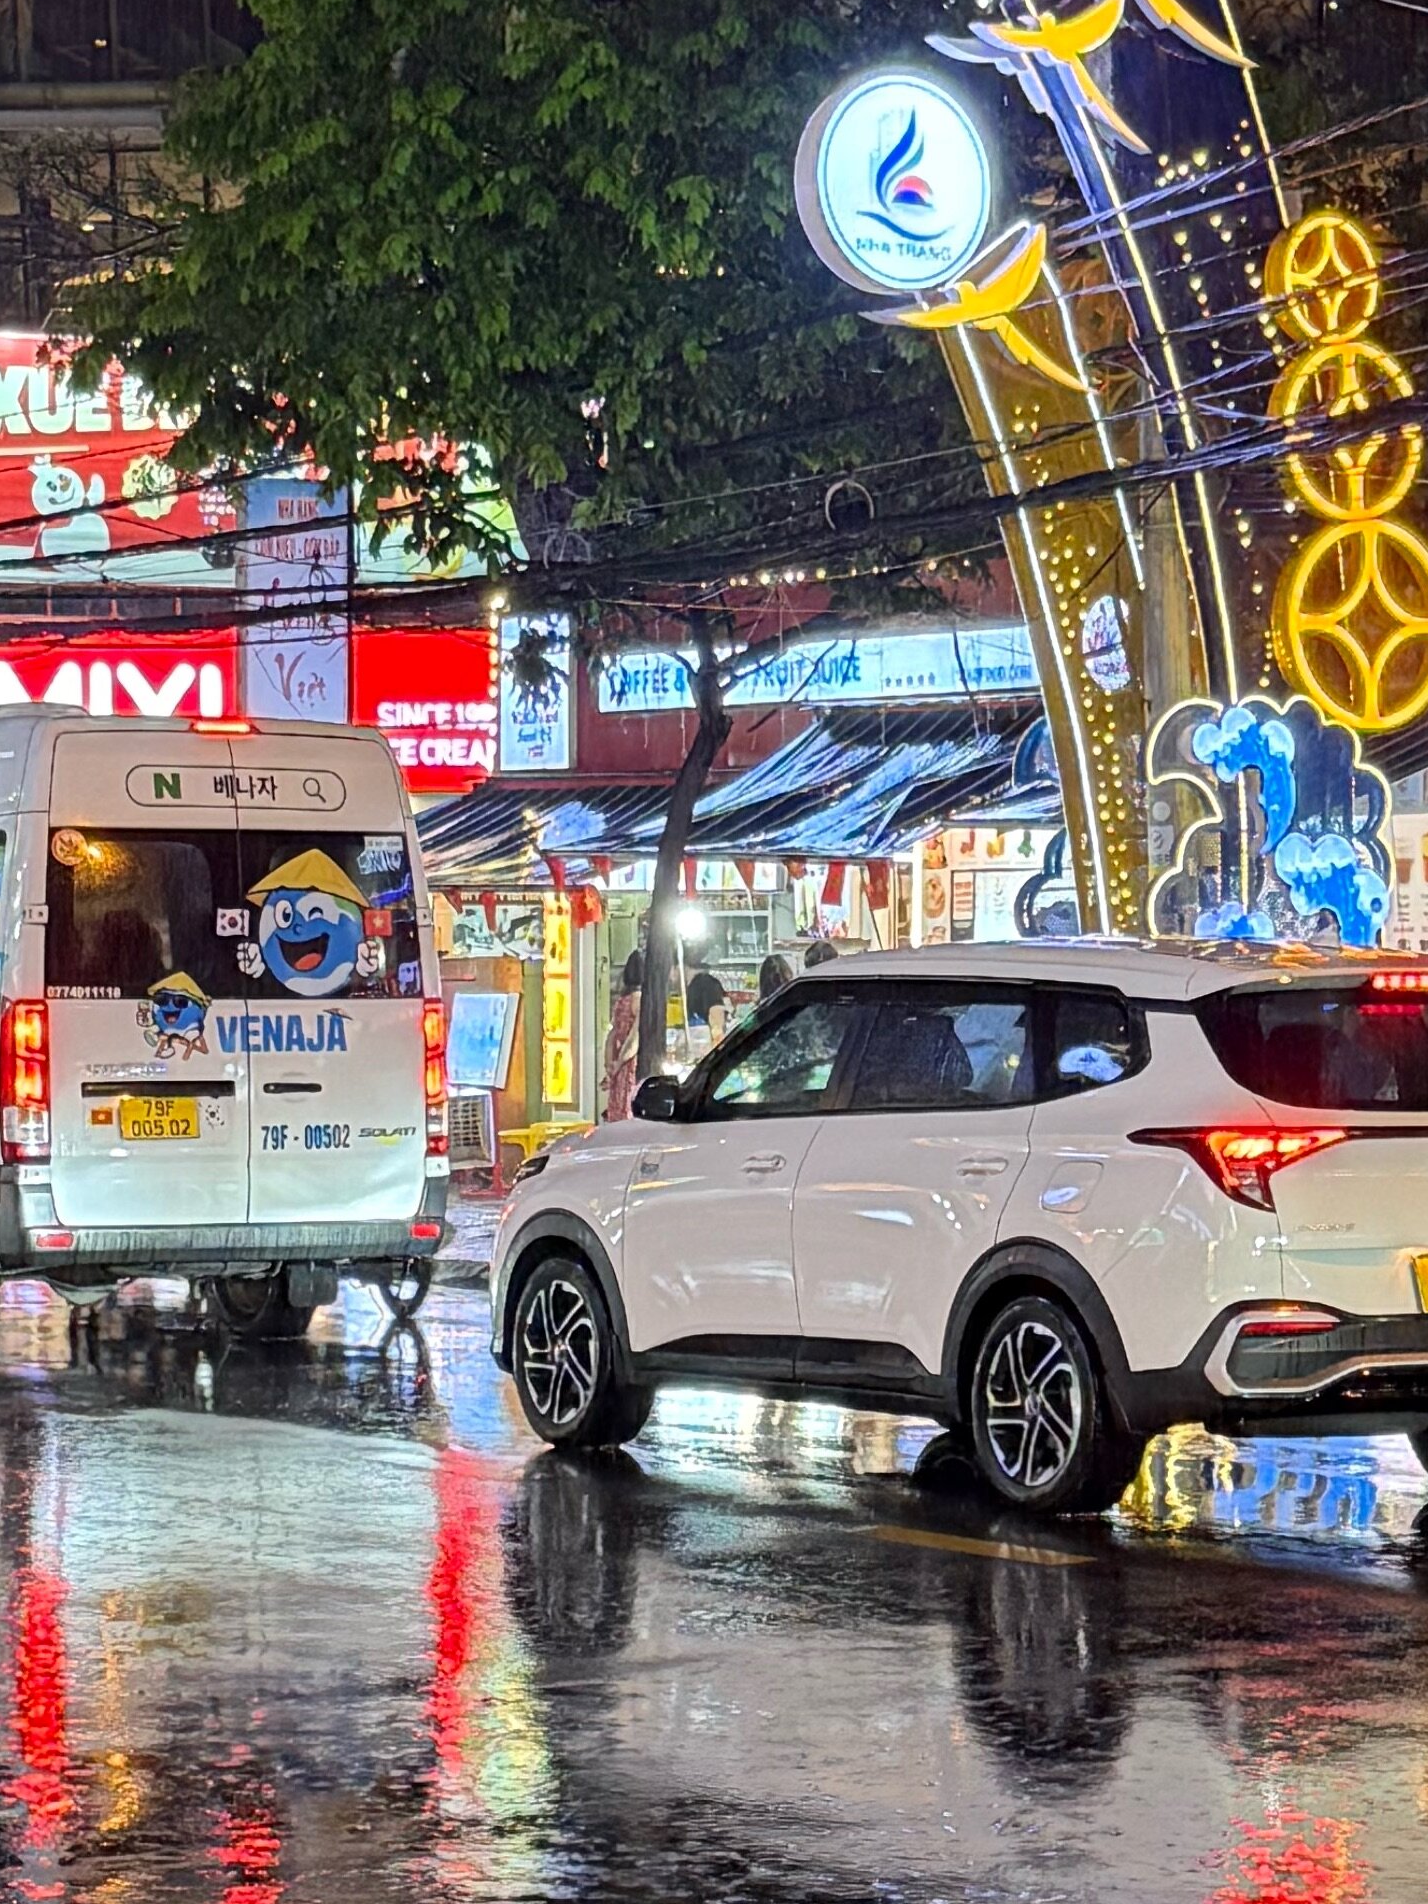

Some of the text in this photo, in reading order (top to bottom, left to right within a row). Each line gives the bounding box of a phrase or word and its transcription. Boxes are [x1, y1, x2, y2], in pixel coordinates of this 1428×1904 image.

[153, 772, 278, 801] N 베나자
[215, 1013, 348, 1054] VENAJA
[142, 1099, 175, 1118] 79F
[131, 1119, 191, 1137] 005.02
[261, 1125, 288, 1150] 79F
[304, 1124, 351, 1149] 00502
[357, 1126, 417, 1138] SOLATI
